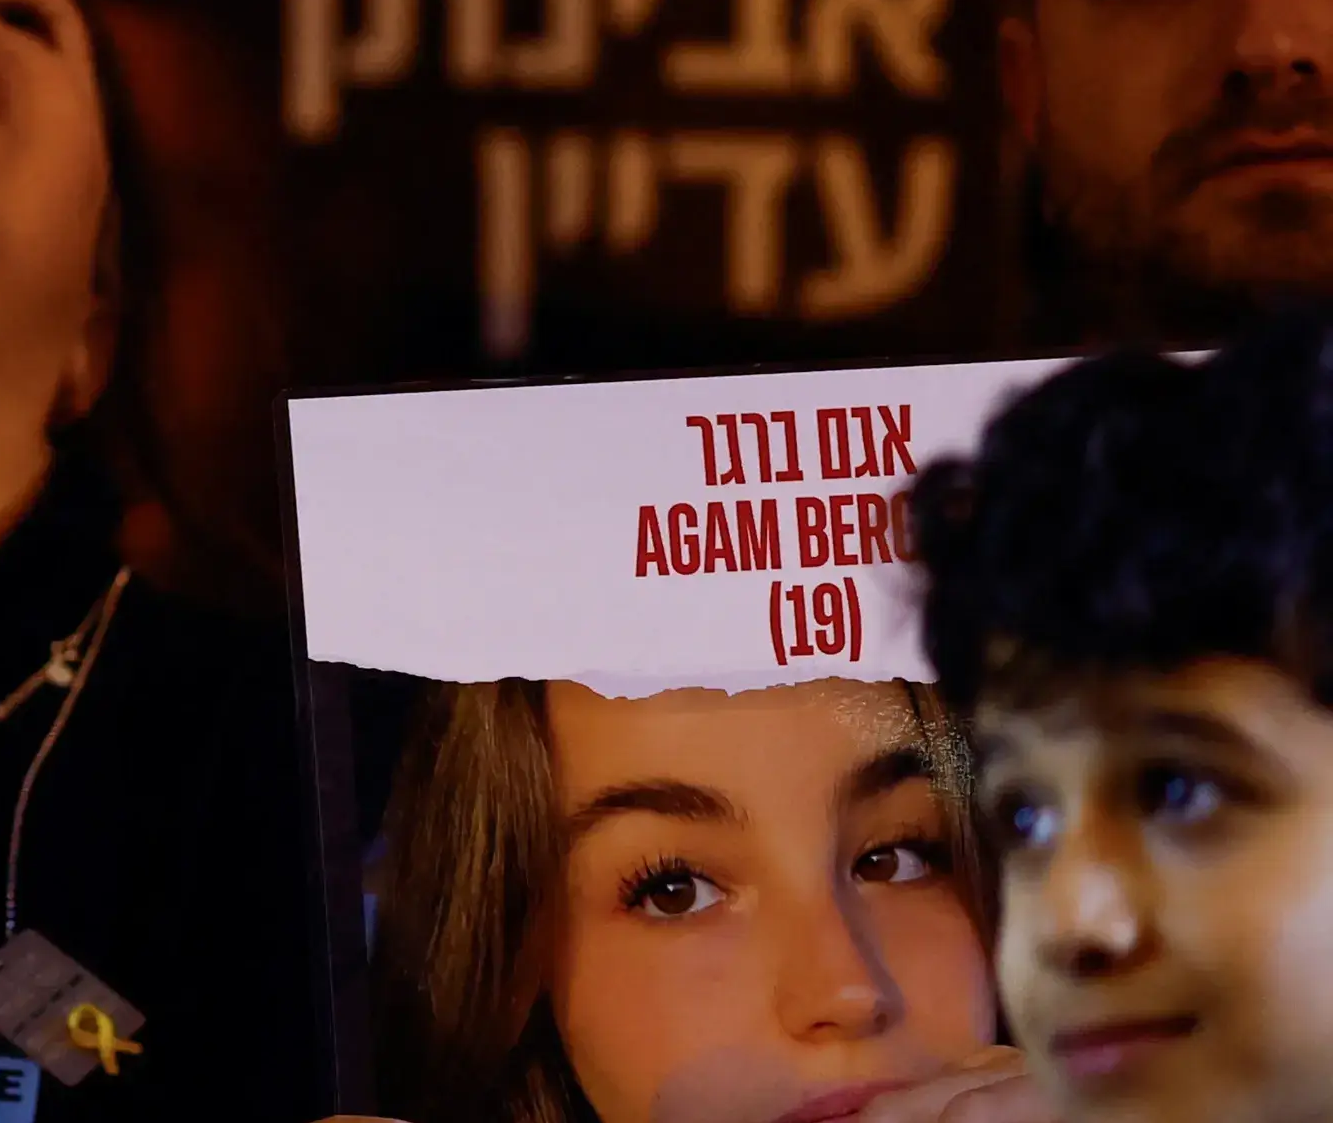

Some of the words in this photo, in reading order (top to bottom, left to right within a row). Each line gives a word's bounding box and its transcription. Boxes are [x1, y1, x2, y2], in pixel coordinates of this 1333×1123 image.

[473, 124, 958, 358] עדיין
[685, 410, 804, 486] ברגר
[816, 404, 918, 480] אגם
[634, 498, 782, 577] AGAM
[769, 577, 863, 666] (19)
